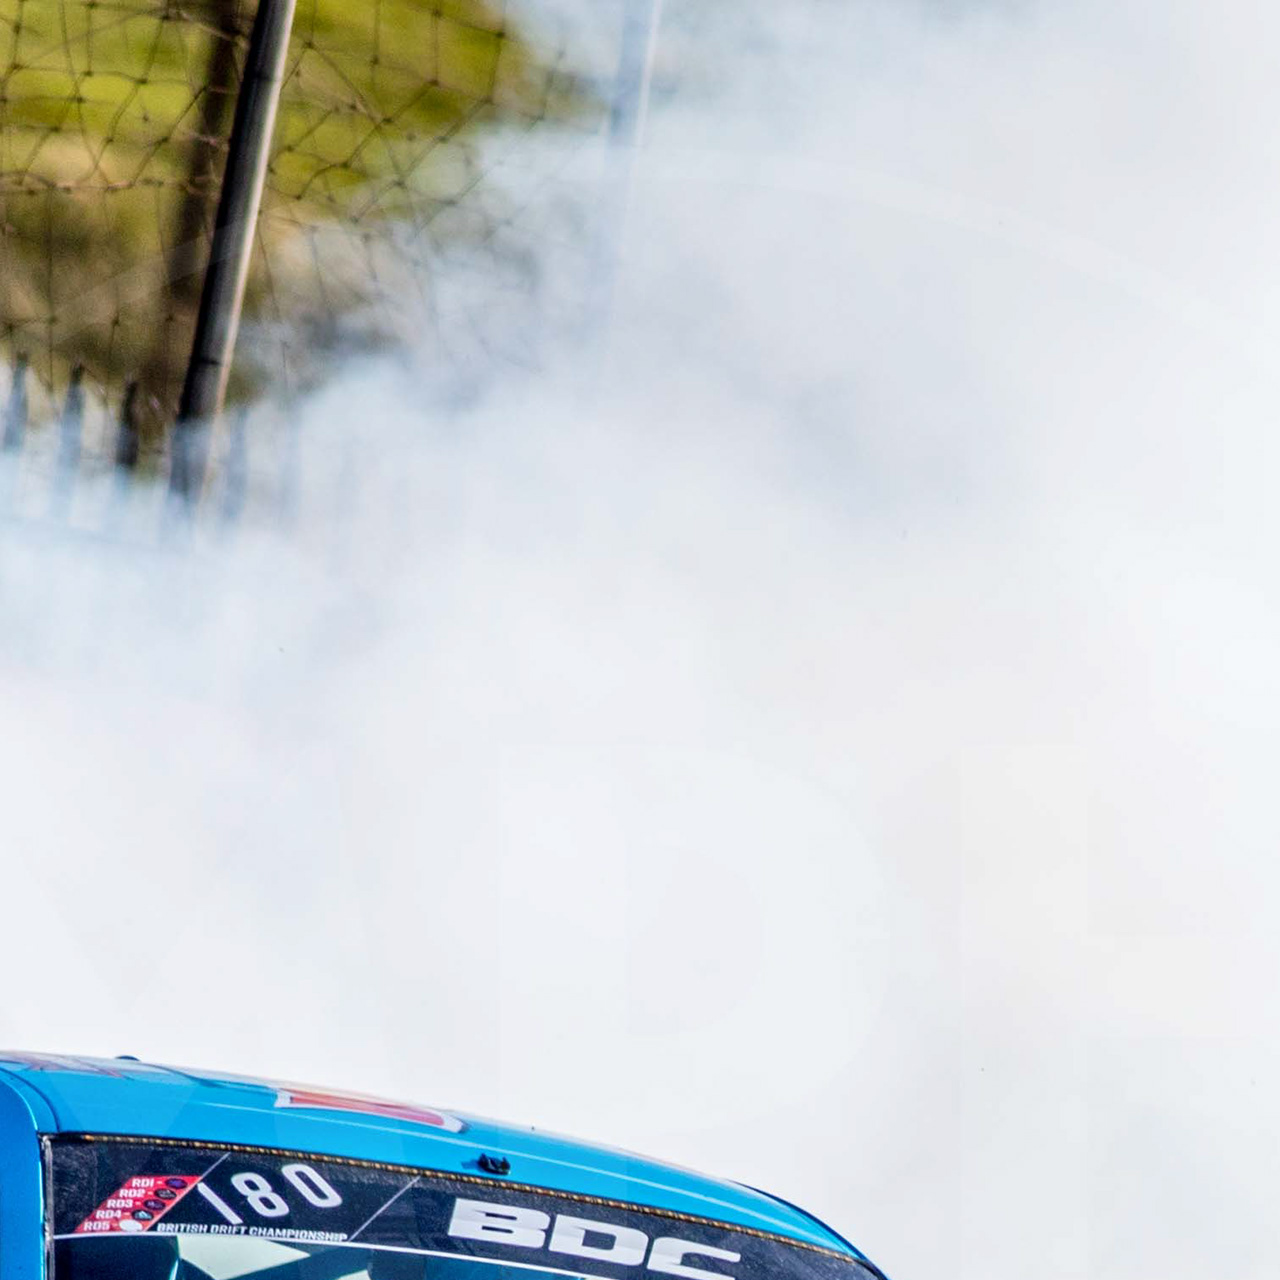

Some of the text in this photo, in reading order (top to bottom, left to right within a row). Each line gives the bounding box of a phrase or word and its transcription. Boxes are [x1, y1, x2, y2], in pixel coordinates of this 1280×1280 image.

[119, 1188, 146, 1198] RD2
[197, 1163, 343, 1225] 180
[107, 1199, 133, 1209] RD3
[96, 1209, 122, 1219] RD4
[84, 1220, 110, 1231] RD5
[157, 1222, 349, 1242] BRITISH DRIFT CHAMPIONSHIP
